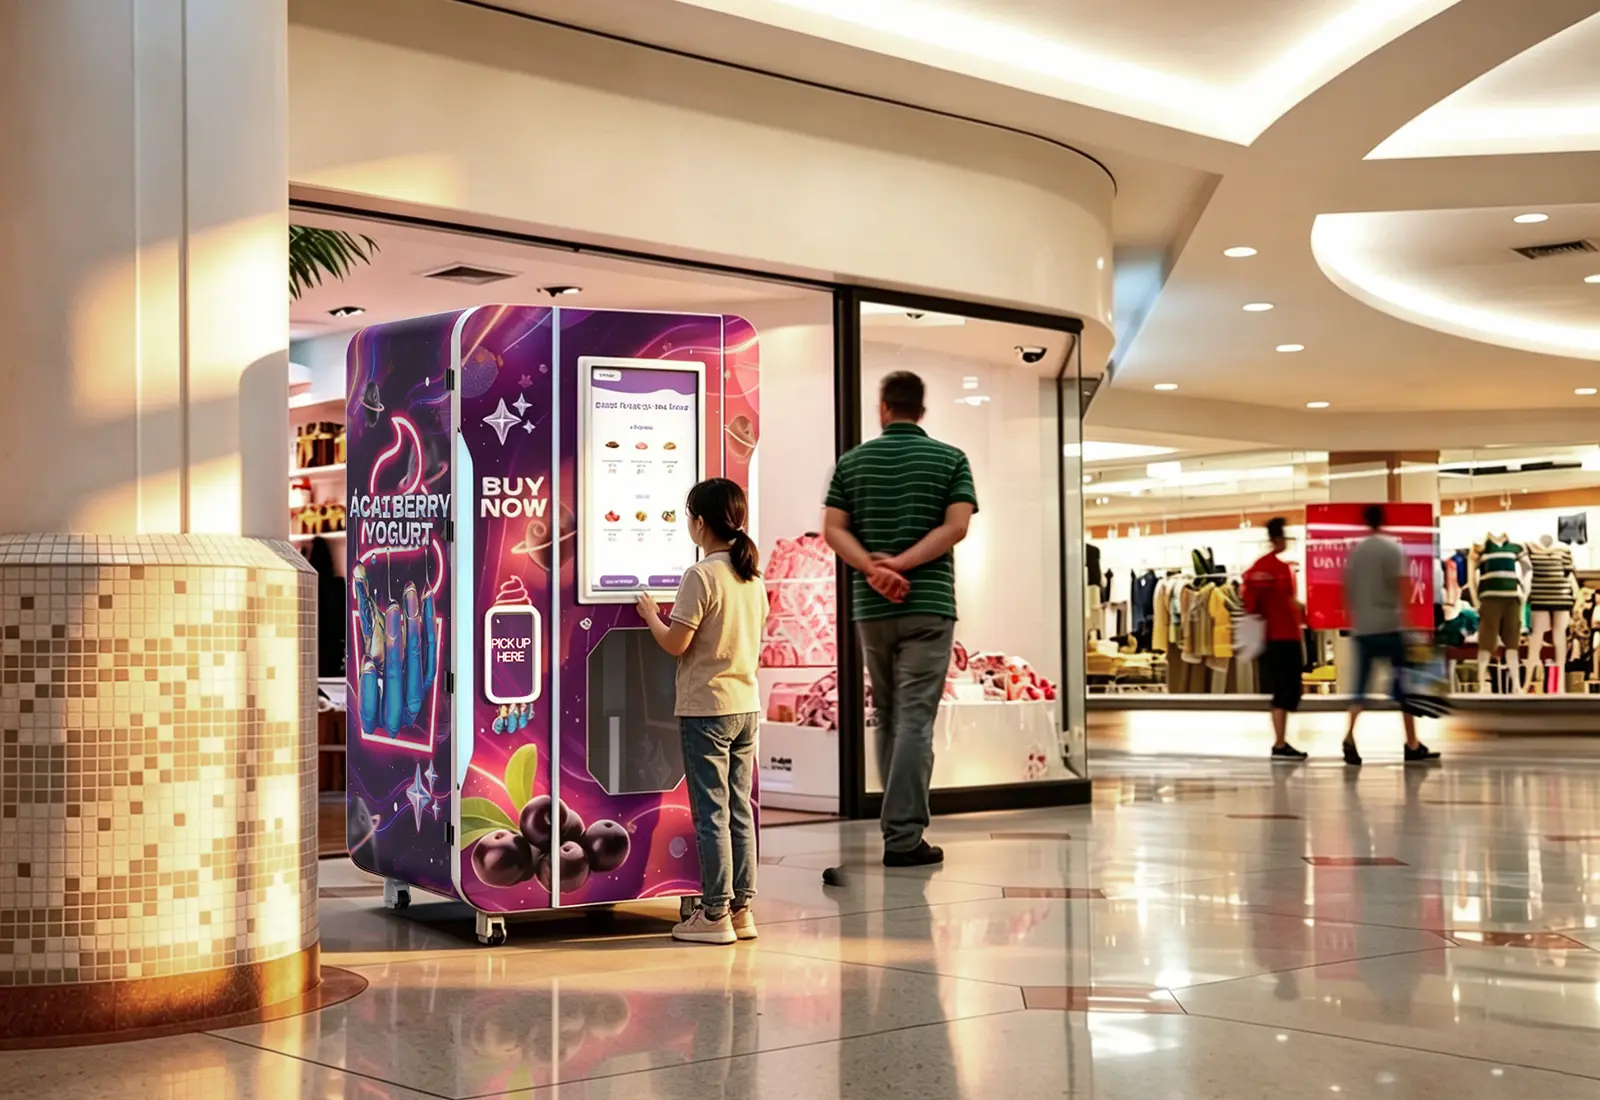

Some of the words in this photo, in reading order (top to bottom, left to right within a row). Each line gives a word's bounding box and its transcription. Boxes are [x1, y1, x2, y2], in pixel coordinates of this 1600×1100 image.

[482, 476, 545, 496] BUY
[480, 498, 548, 518] NOW
[364, 520, 434, 545] YOGURT
[491, 637, 515, 649] PICK
[516, 637, 531, 649] UP
[497, 651, 525, 662] HERE
